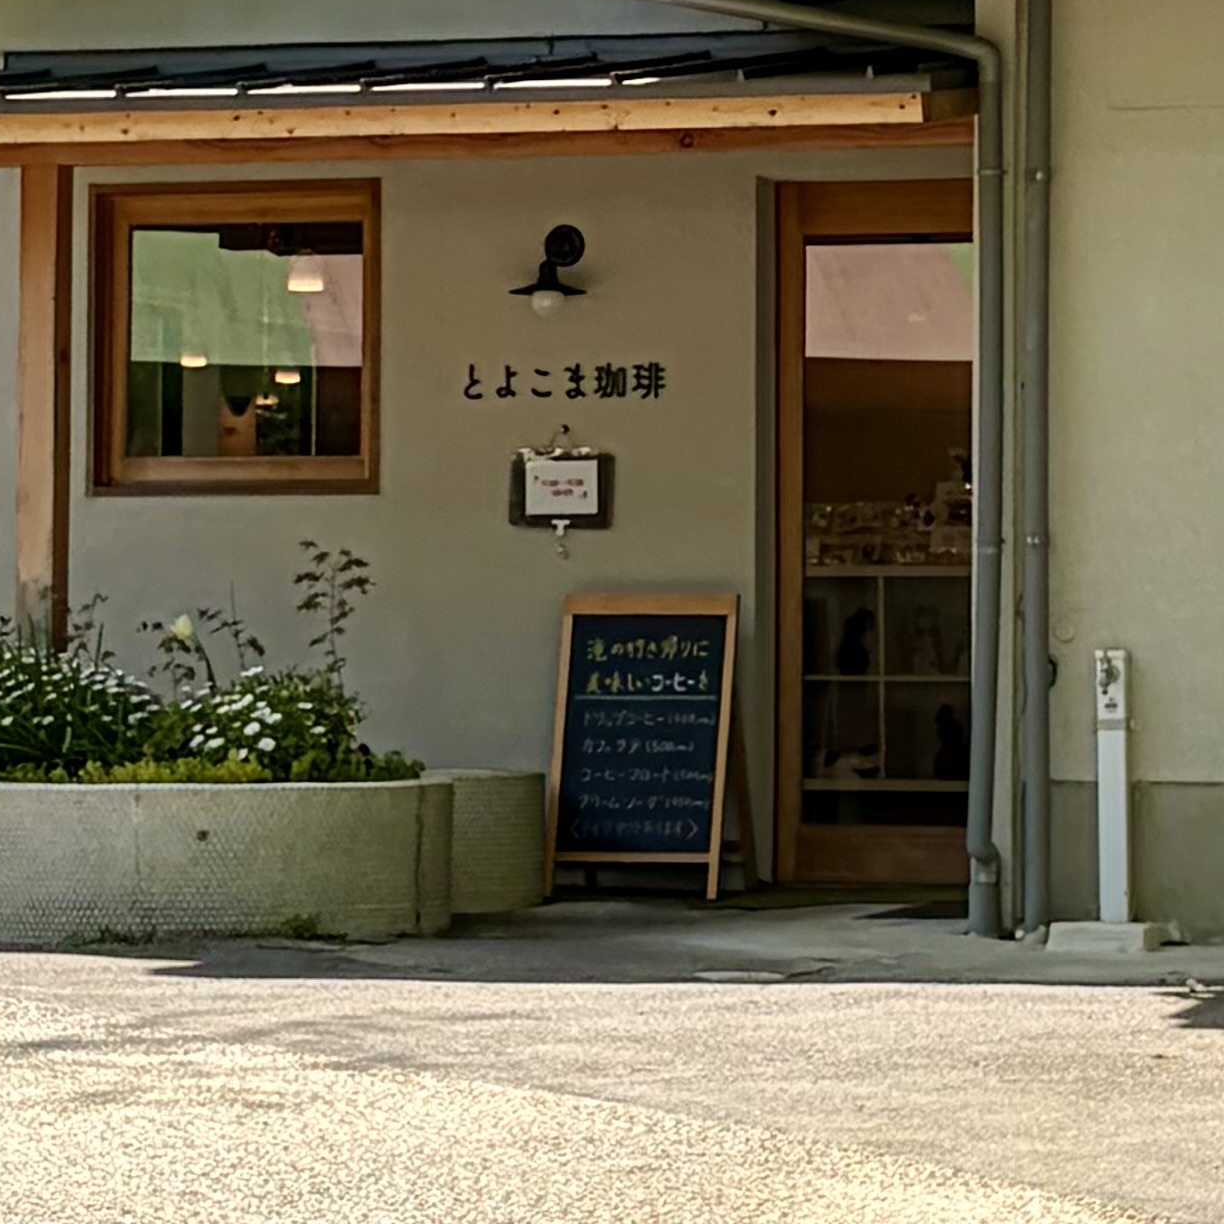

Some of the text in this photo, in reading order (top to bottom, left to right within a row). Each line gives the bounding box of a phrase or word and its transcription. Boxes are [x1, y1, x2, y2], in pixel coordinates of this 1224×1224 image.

[463, 362, 666, 399] とよこま珈琲
